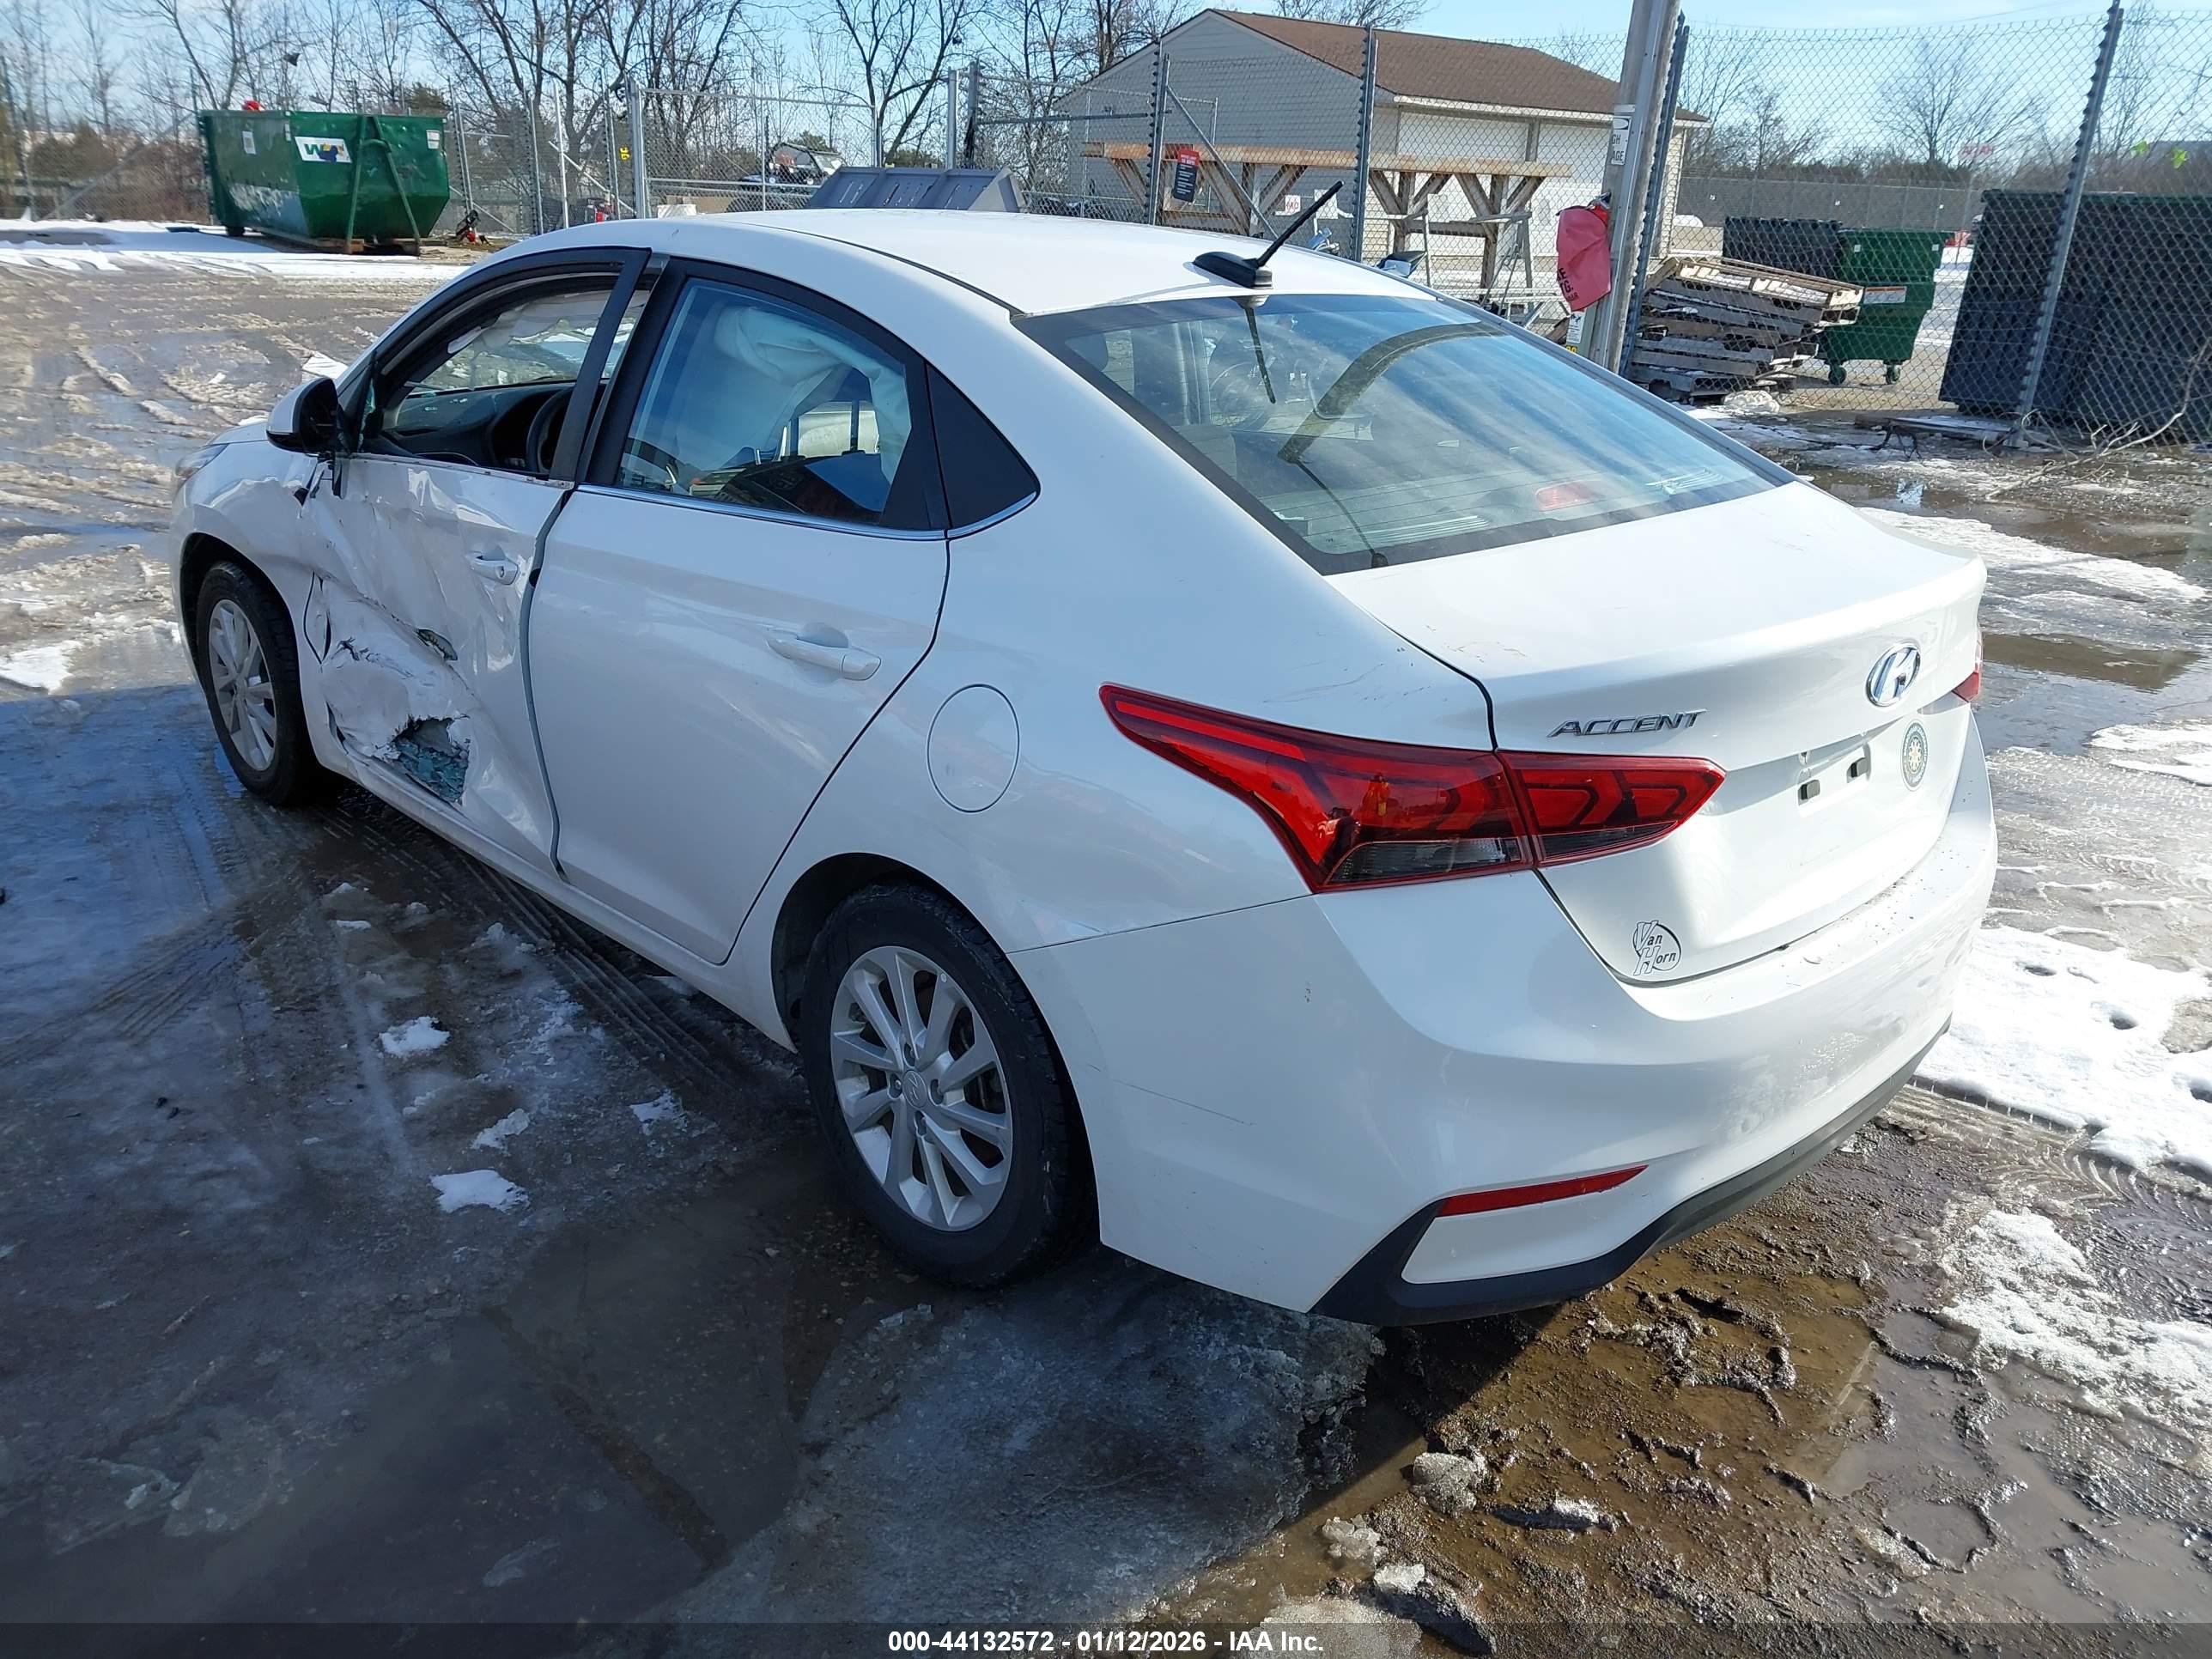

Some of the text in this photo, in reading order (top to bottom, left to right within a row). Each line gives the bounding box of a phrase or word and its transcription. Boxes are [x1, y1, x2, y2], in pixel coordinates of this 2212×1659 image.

[1611, 133, 1622, 145] GH
[1547, 708, 1709, 738] ACCENT
[1634, 919, 1663, 952] Van
[1632, 945, 1677, 976] Horn
